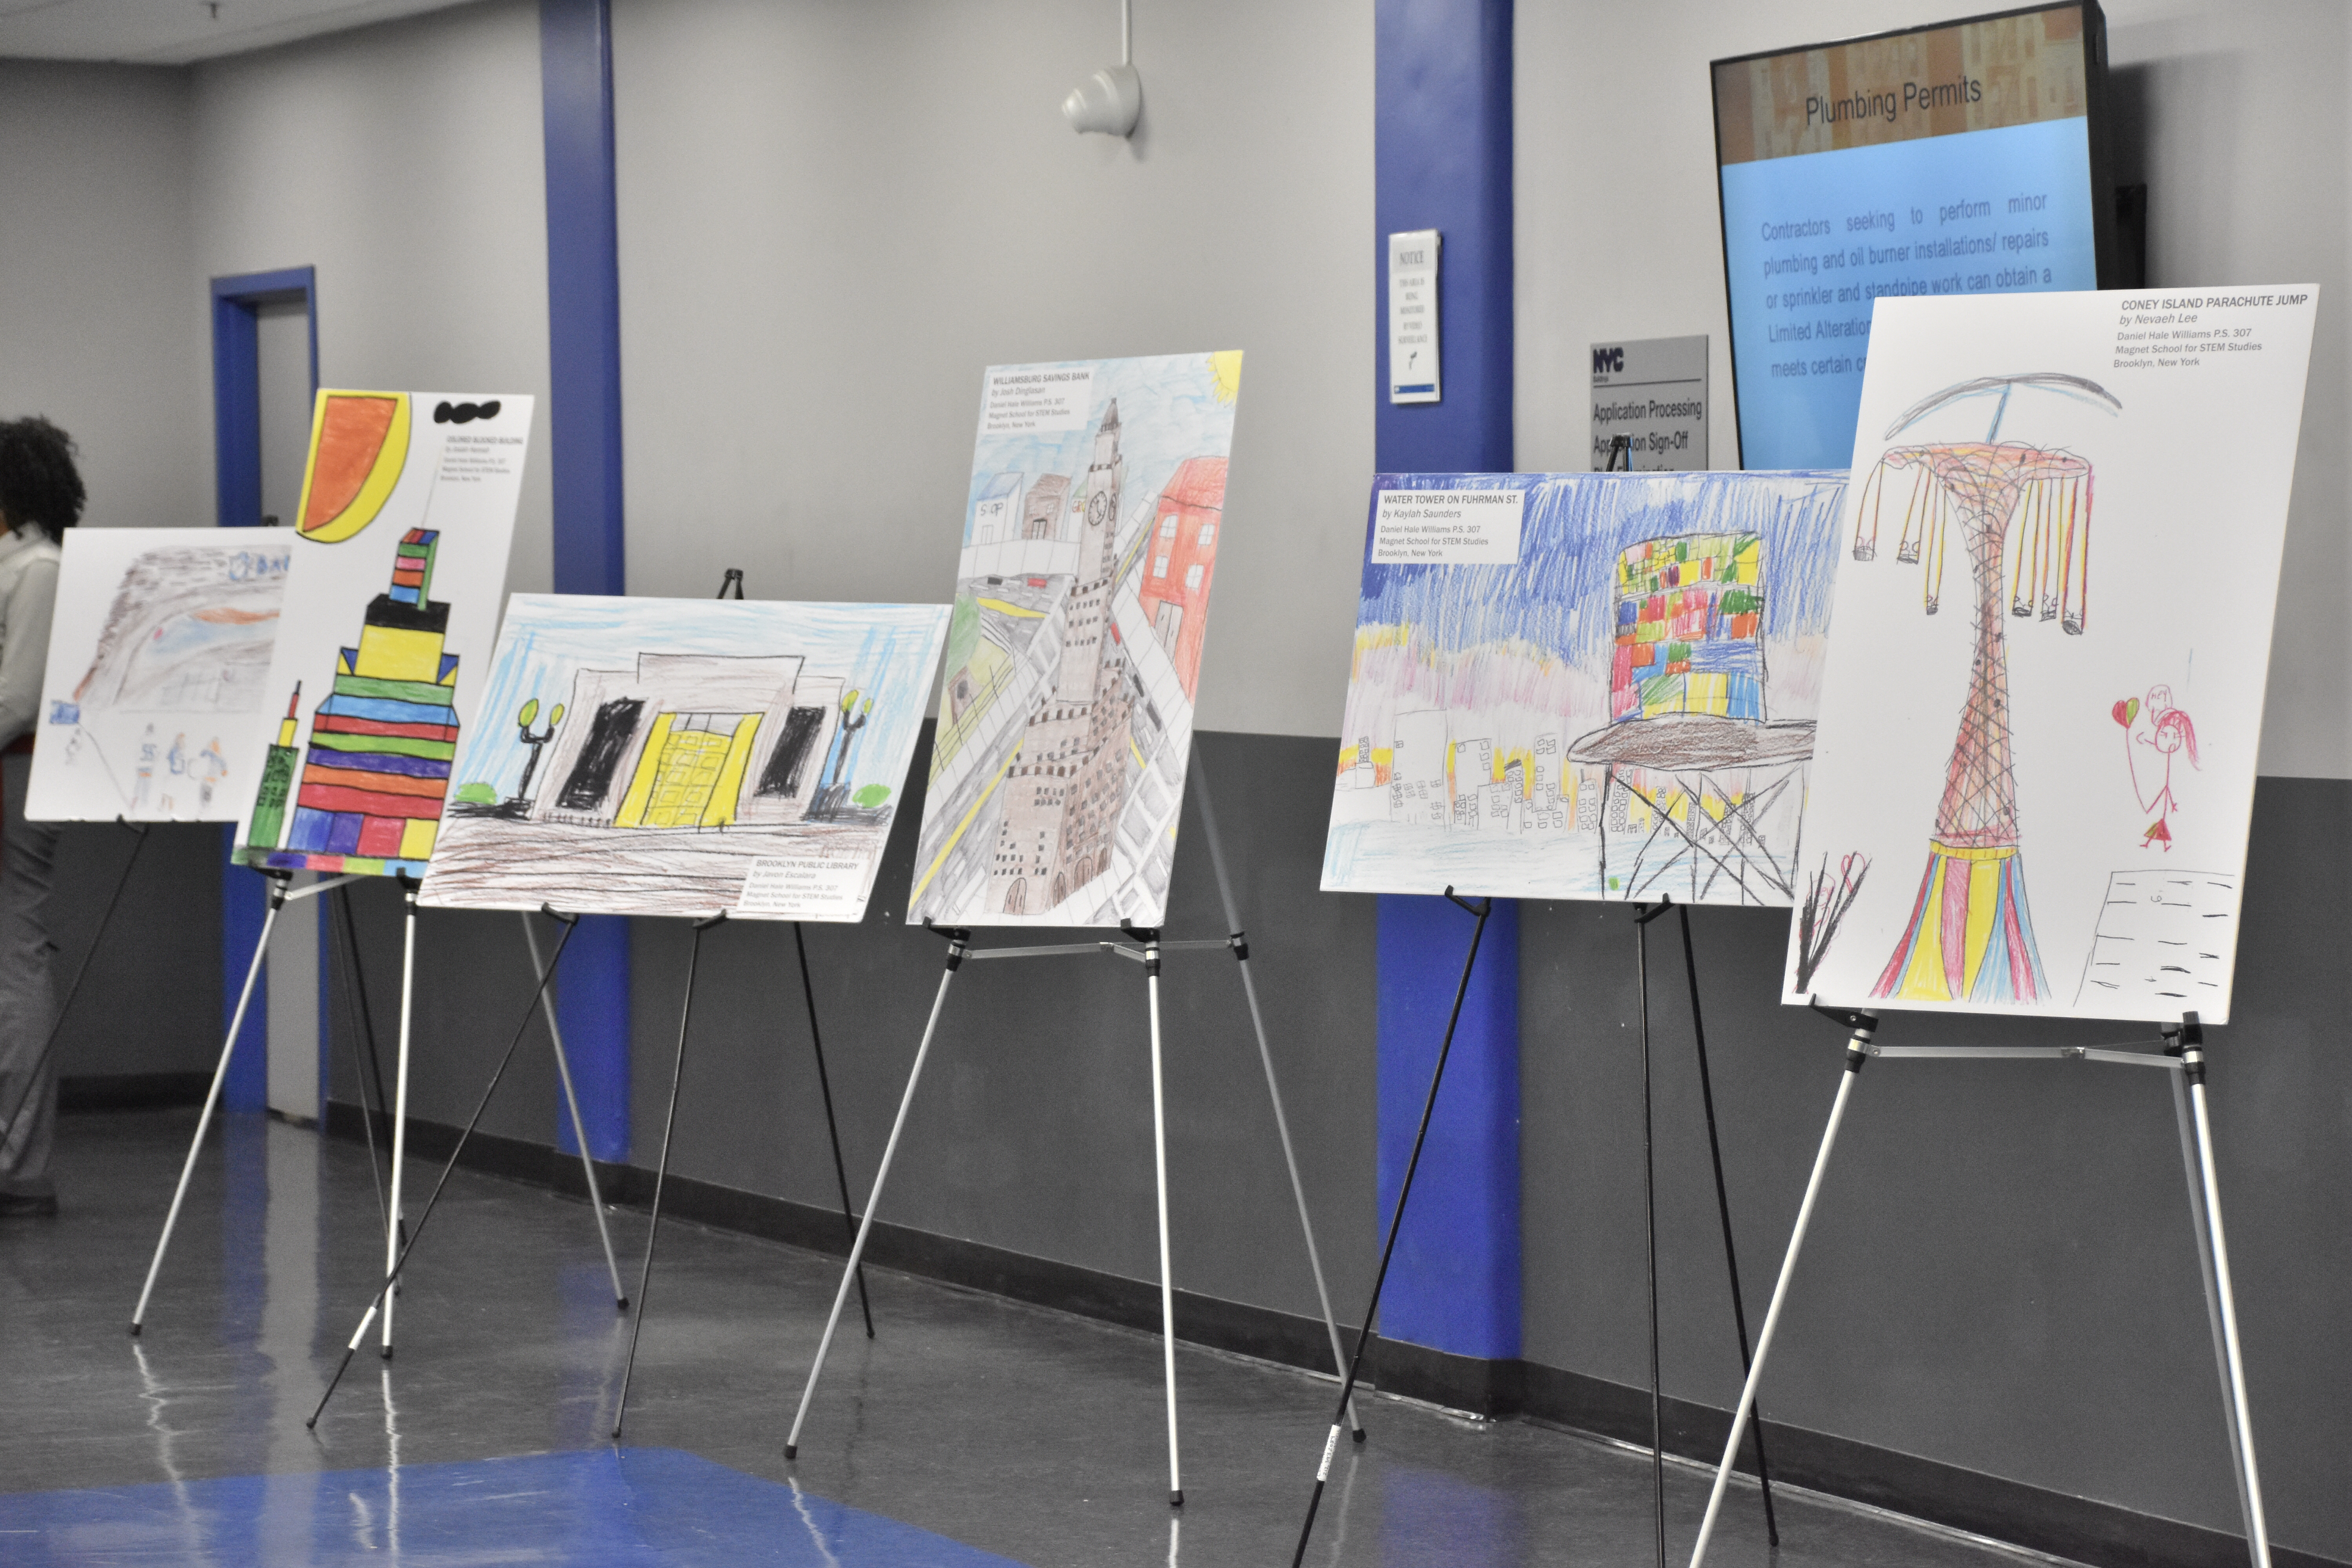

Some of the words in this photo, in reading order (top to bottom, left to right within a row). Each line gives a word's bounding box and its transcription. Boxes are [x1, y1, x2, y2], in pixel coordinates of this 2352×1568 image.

[1806, 88, 1896, 125] Plumbing
[1904, 76, 1981, 111] Permits
[1762, 217, 1830, 241] Contractors
[1847, 209, 1895, 232] seeking
[1911, 207, 1923, 225] to
[1940, 200, 1990, 226] perform
[2008, 193, 2047, 213] minor
[1764, 252, 1817, 278] plumbing
[1823, 249, 1845, 270] and
[1850, 247, 1864, 267] oil
[1869, 244, 1910, 265] burner
[1915, 232, 1996, 259] installations/
[2001, 230, 2048, 254] repairs
[1766, 294, 1778, 309] or
[1783, 286, 1833, 311] sprinkler
[1838, 282, 1860, 302] and
[1866, 276, 1927, 299] standpipe
[1932, 272, 1962, 293] work
[1967, 274, 1990, 290] can
[1996, 265, 2036, 287] obtain
[2043, 268, 2051, 283] a
[2122, 299, 2158, 310] CONEY
[2162, 298, 2203, 309] ISLAND
[2207, 296, 2274, 307] PARACHUTE
[2276, 294, 2307, 305] JUMP
[2119, 315, 2132, 326] by
[2135, 314, 2174, 324] Nevaeh
[2178, 314, 2198, 323] Lee
[1768, 322, 1811, 343] Limited
[2118, 332, 2146, 340] Daniel
[2149, 331, 2169, 339] Hale
[2172, 330, 2211, 338] Williams
[2233, 328, 2251, 337] 307
[2116, 346, 2149, 355] Magnet
[2152, 345, 2182, 353] School
[2200, 343, 2225, 352] STEM
[2228, 343, 2262, 351] Studies
[1593, 347, 1624, 374] NYC
[1771, 359, 1807, 377] meets
[1811, 355, 1852, 375] certain
[2114, 359, 2155, 368] Brooklyn,
[994, 375, 1041, 385] WILLIAMSBURG
[1043, 373, 1070, 382] SAVINGS
[1072, 372, 1090, 380] BANK
[1000, 388, 1014, 396] Josh
[1593, 401, 1646, 425] Application
[1650, 397, 1702, 420] Processing
[1650, 431, 1688, 455] Sign-Off
[1384, 495, 1412, 504] WATER
[1415, 495, 1445, 504] TOWER
[1447, 495, 1459, 504] ON
[1462, 495, 1504, 504] FUHRMAN
[1506, 495, 1518, 504] ST.
[1382, 510, 1391, 519] by
[1394, 509, 1421, 519] Kaylah
[1423, 510, 1461, 518] Saunders
[756, 859, 796, 868] BROOKLYN
[826, 862, 859, 870] LIBRARY
